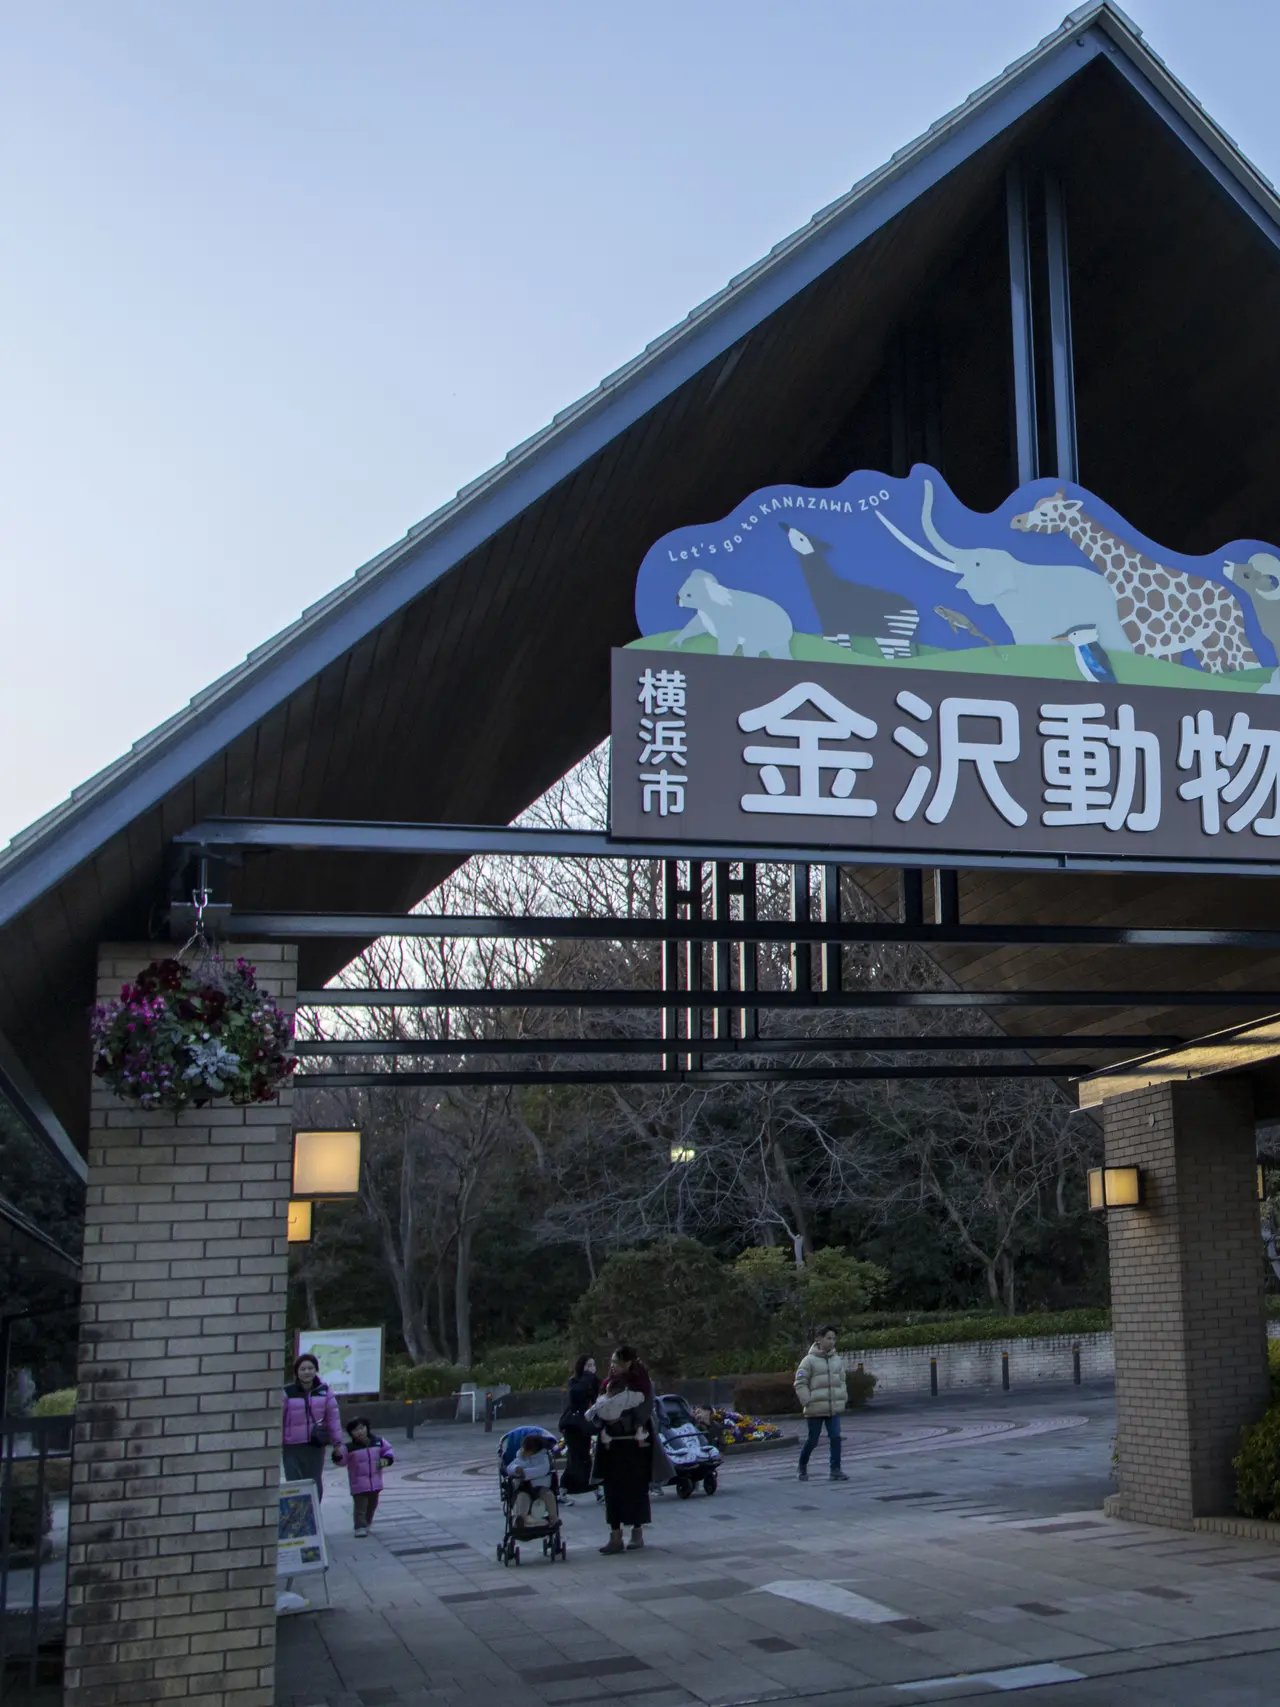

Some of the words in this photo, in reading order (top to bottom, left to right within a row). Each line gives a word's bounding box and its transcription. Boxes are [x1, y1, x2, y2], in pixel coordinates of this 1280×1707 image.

[668, 543, 717, 562] Let's
[723, 534, 743, 552] go
[741, 515, 759, 531] to
[759, 496, 852, 513] KANAZAWA
[858, 489, 890, 511] ZOO
[637, 668, 688, 817] 横浜市
